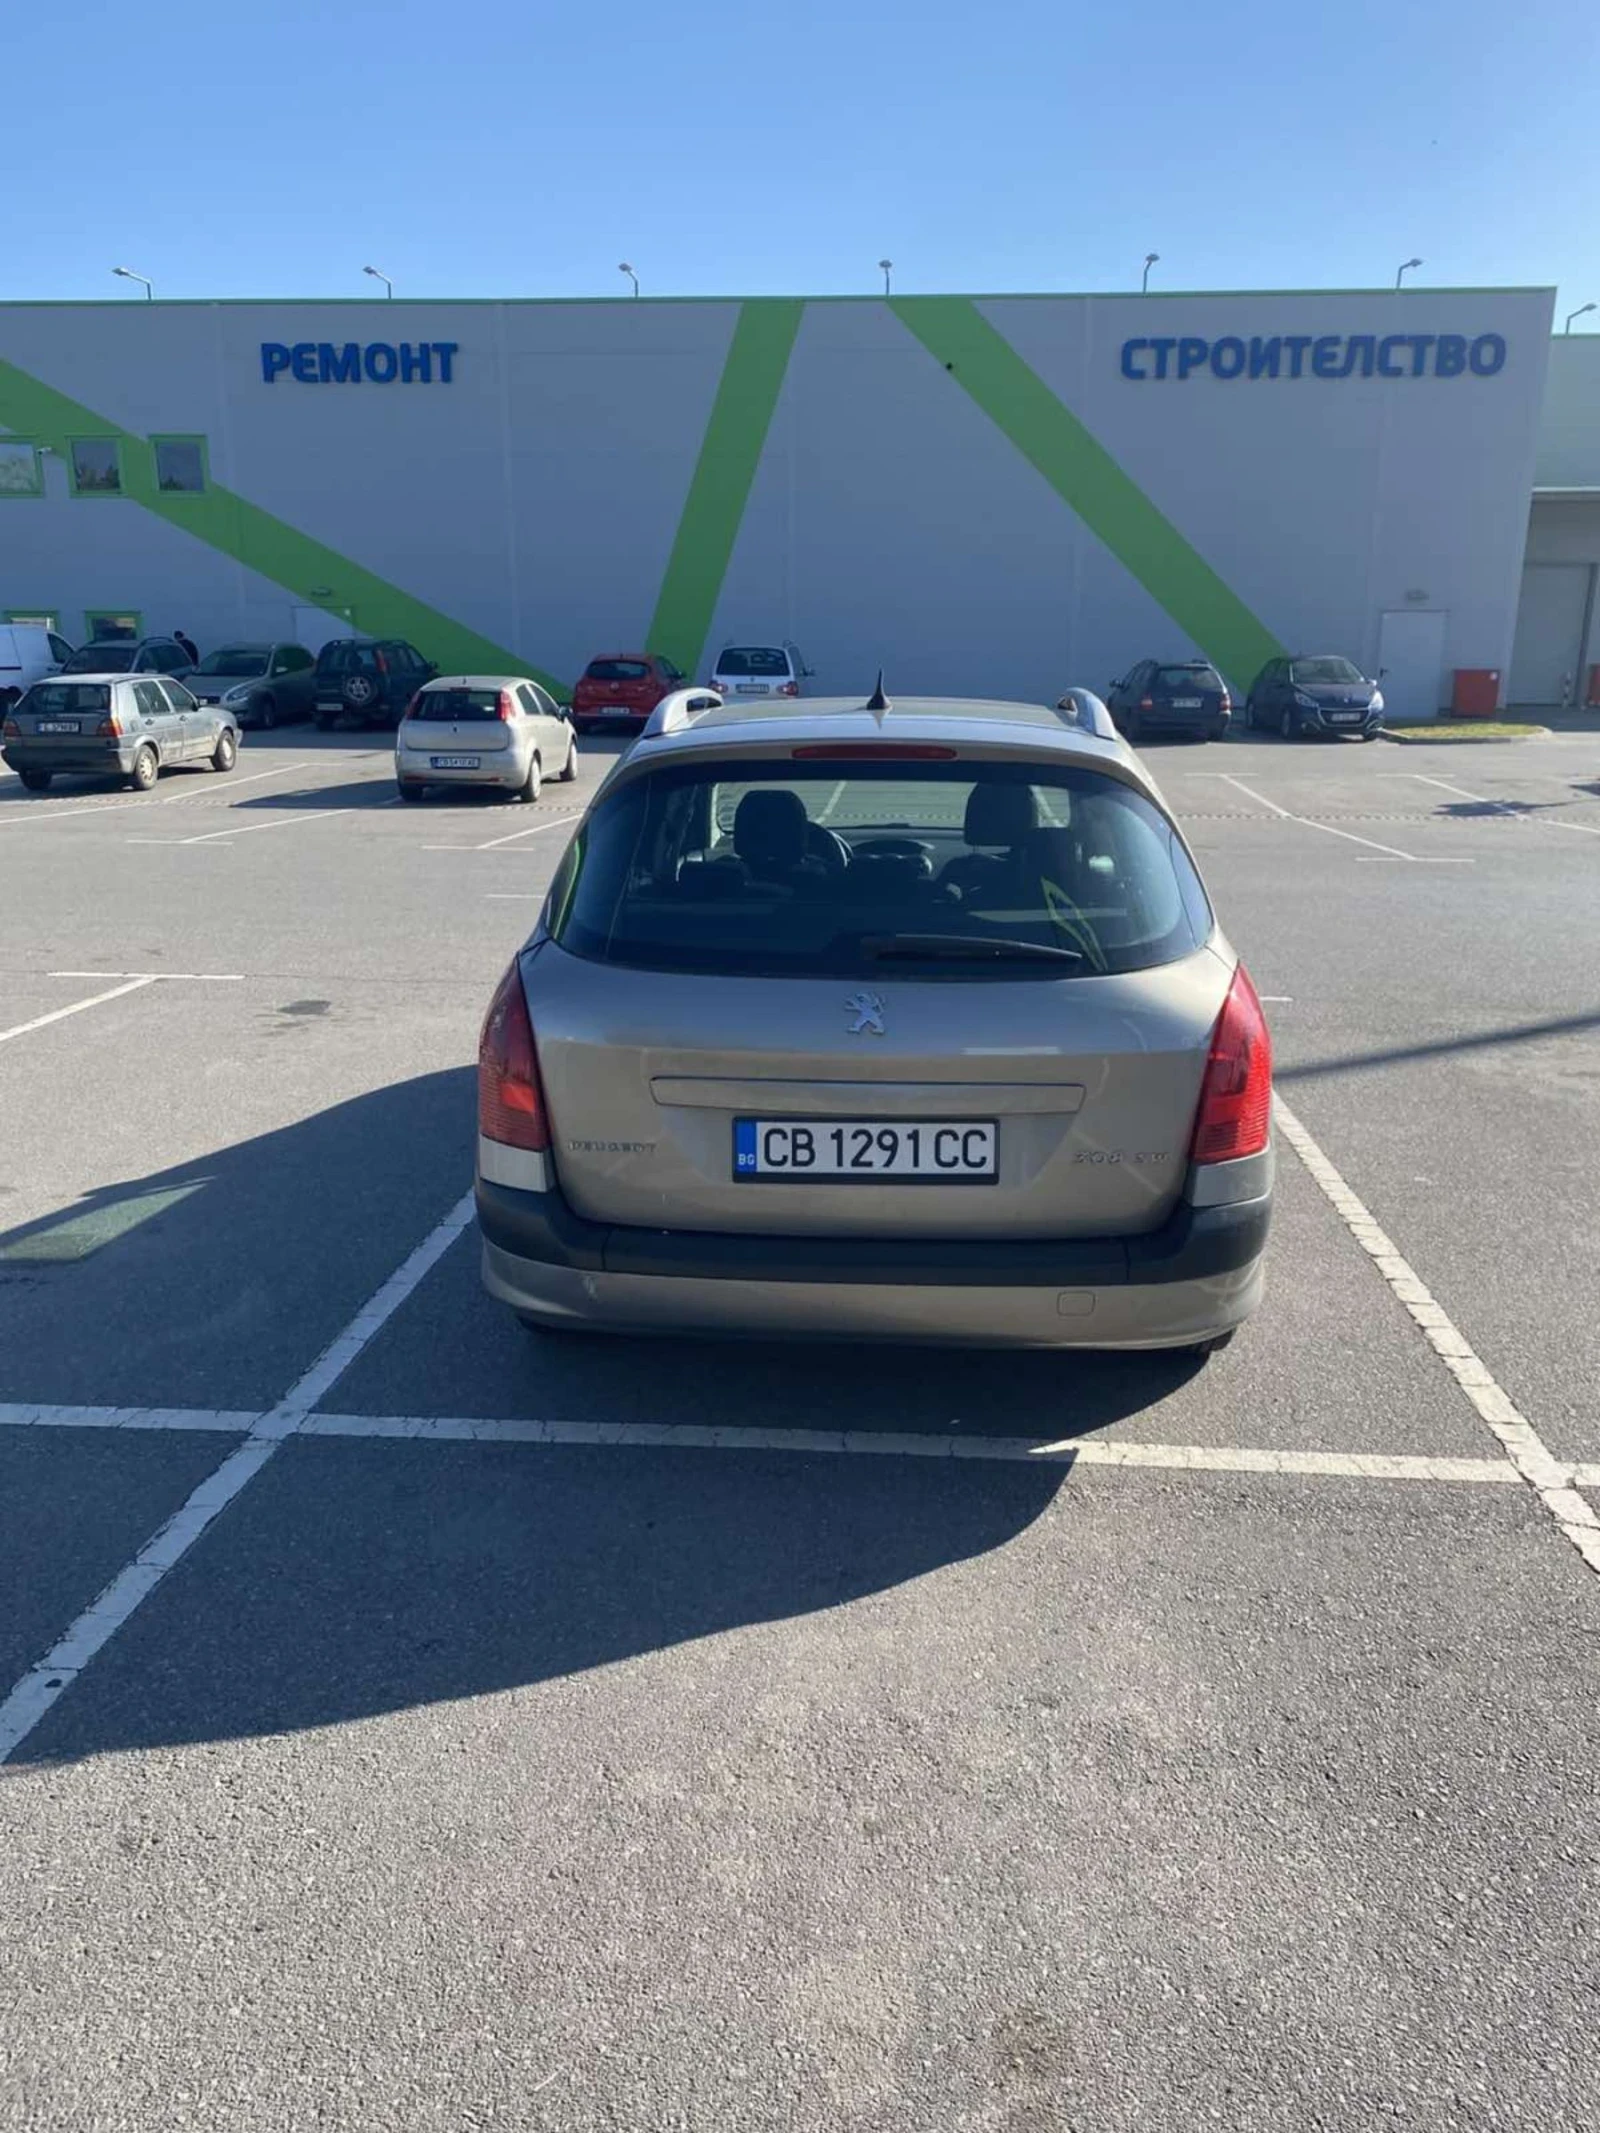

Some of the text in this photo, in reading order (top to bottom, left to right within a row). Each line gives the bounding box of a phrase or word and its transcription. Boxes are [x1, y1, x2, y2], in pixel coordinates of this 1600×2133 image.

[260, 342, 458, 383] РЕМОНТ
[1121, 333, 1507, 380] СТРОИТЕЛСТВО
[738, 1153, 755, 1165] BG
[763, 1128, 988, 1168] CB 1291 CC
